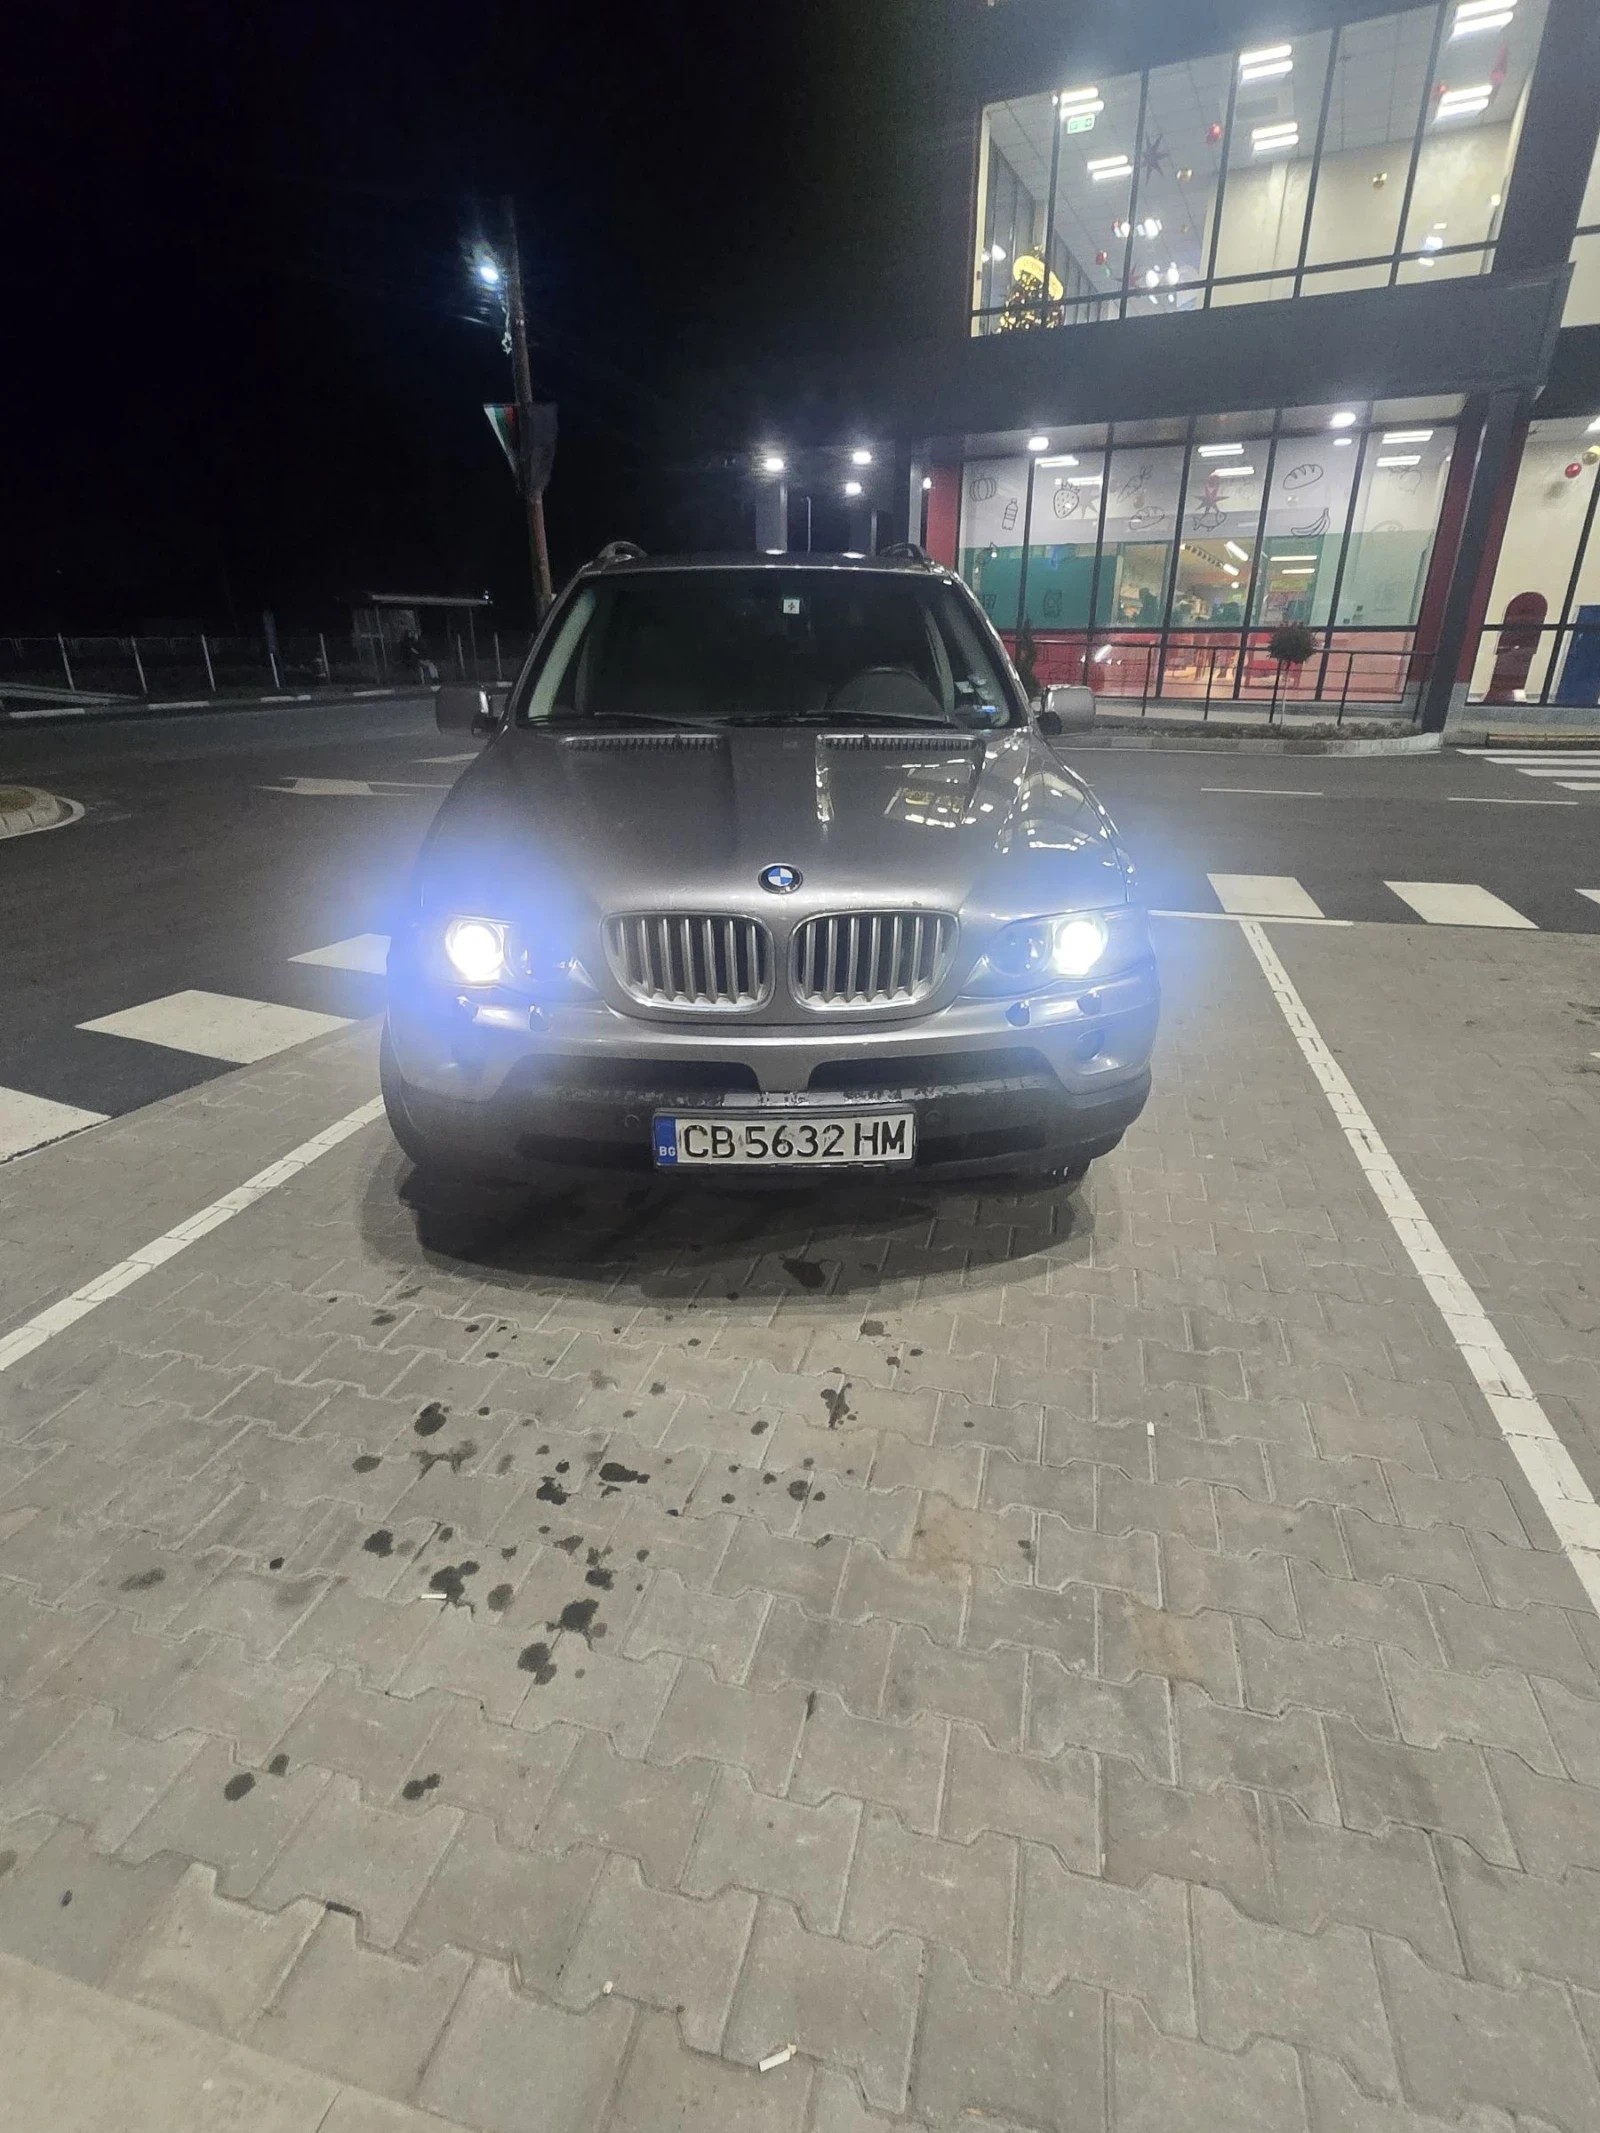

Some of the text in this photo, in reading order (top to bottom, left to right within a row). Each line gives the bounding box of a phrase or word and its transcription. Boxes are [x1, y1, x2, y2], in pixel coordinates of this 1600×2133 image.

[684, 1120, 906, 1158] CB 5632 HM
[660, 1146, 676, 1157] BG
